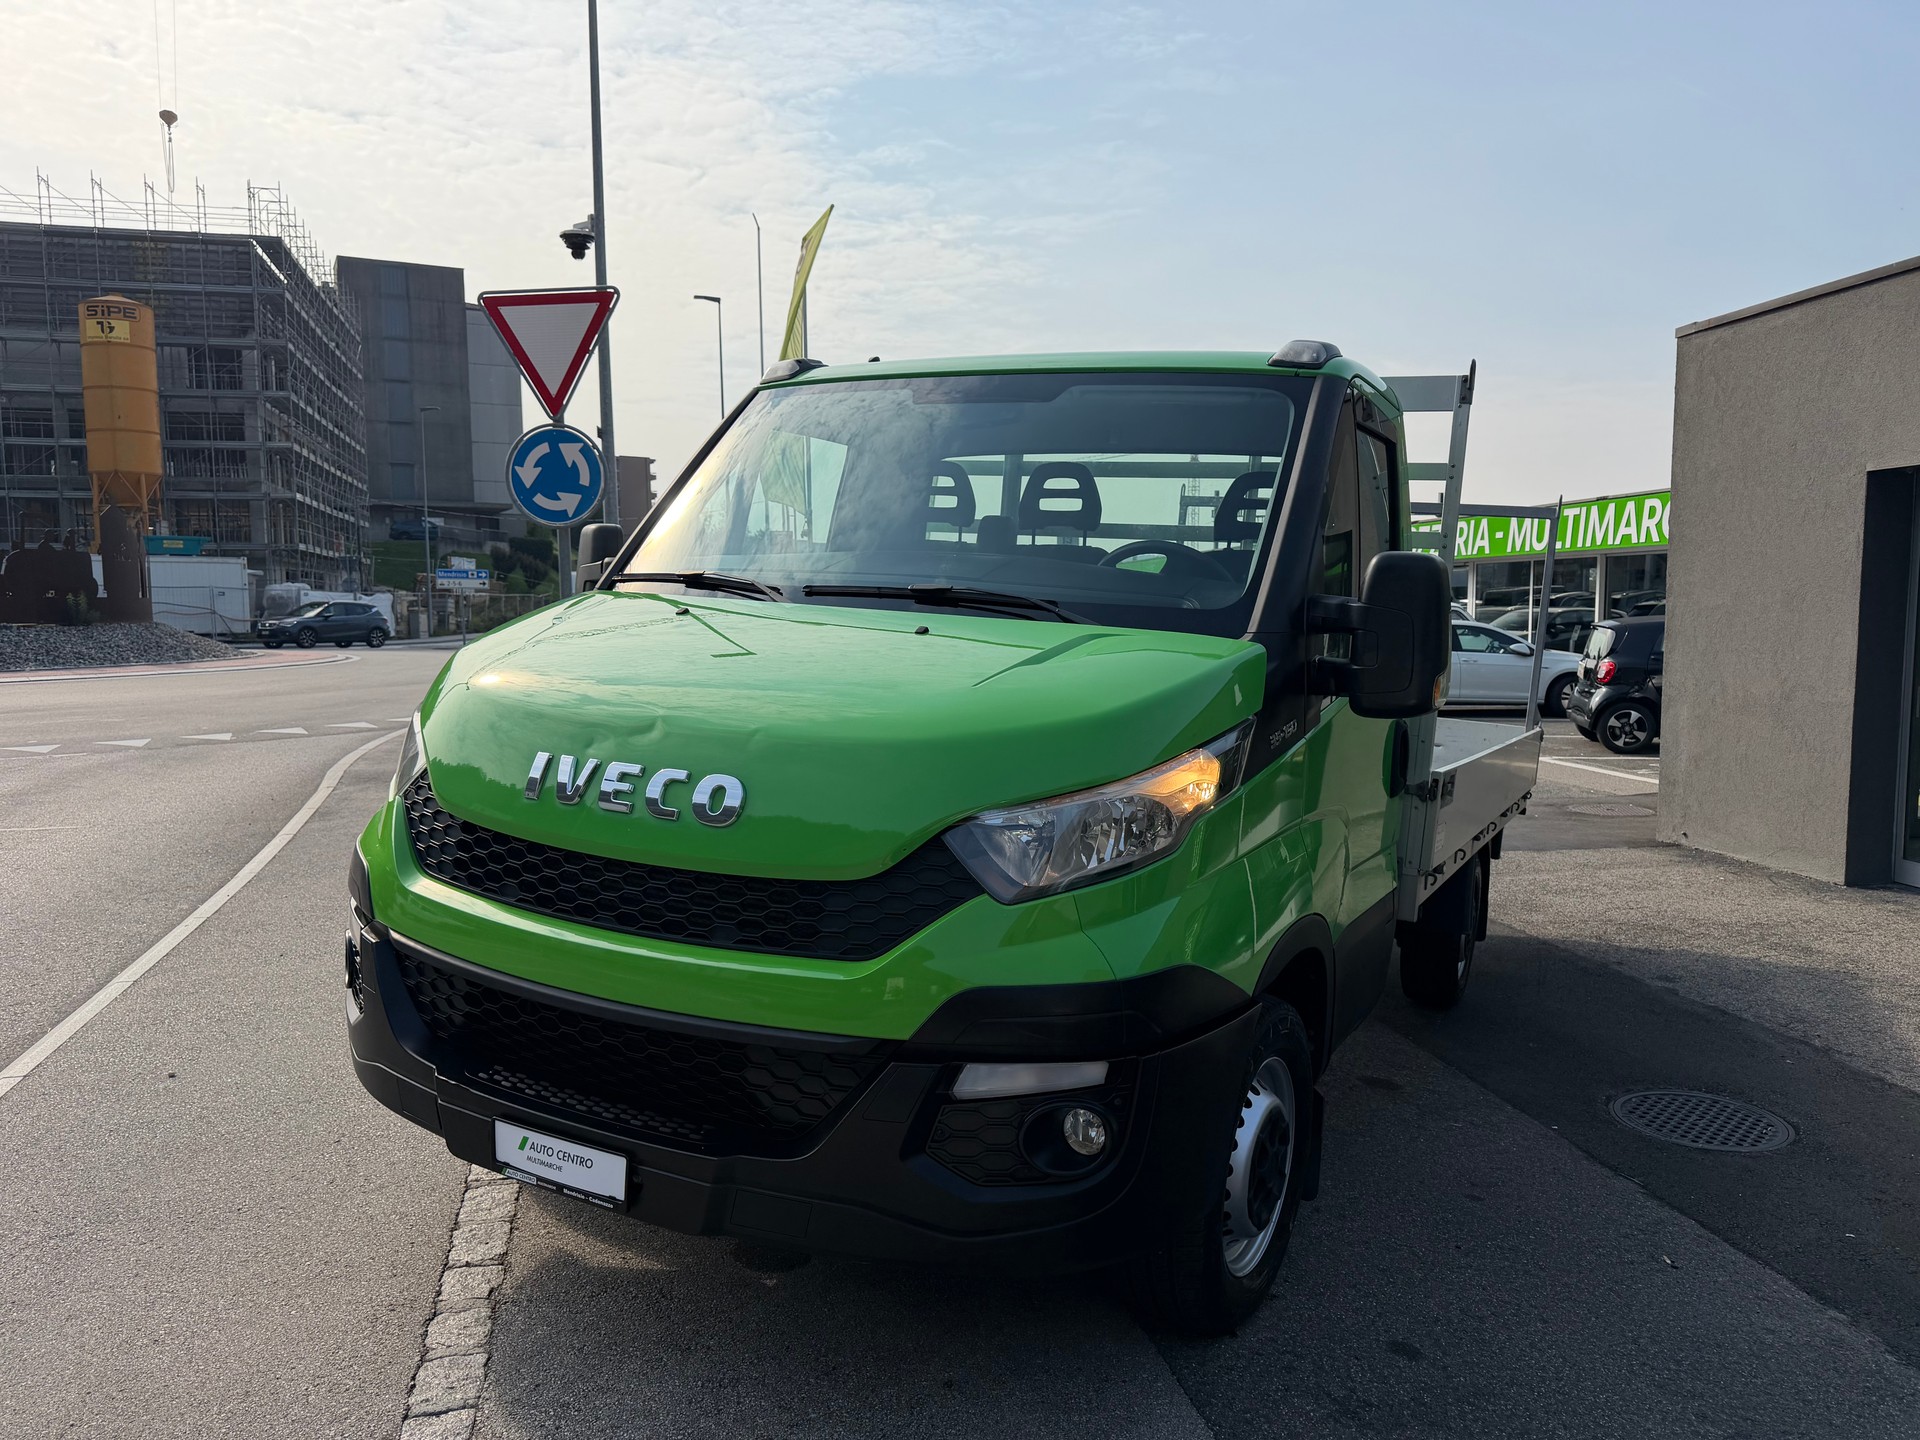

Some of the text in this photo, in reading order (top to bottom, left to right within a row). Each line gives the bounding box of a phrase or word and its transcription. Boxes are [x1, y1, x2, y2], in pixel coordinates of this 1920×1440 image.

[1506, 498, 1671, 553] MUTIMAR
[524, 751, 748, 827] IVECO
[526, 1155, 563, 1173] MULTIMARCHE
[529, 1141, 594, 1169] AUTO CENTRO
[506, 1169, 536, 1183] AUTO CENTRO
